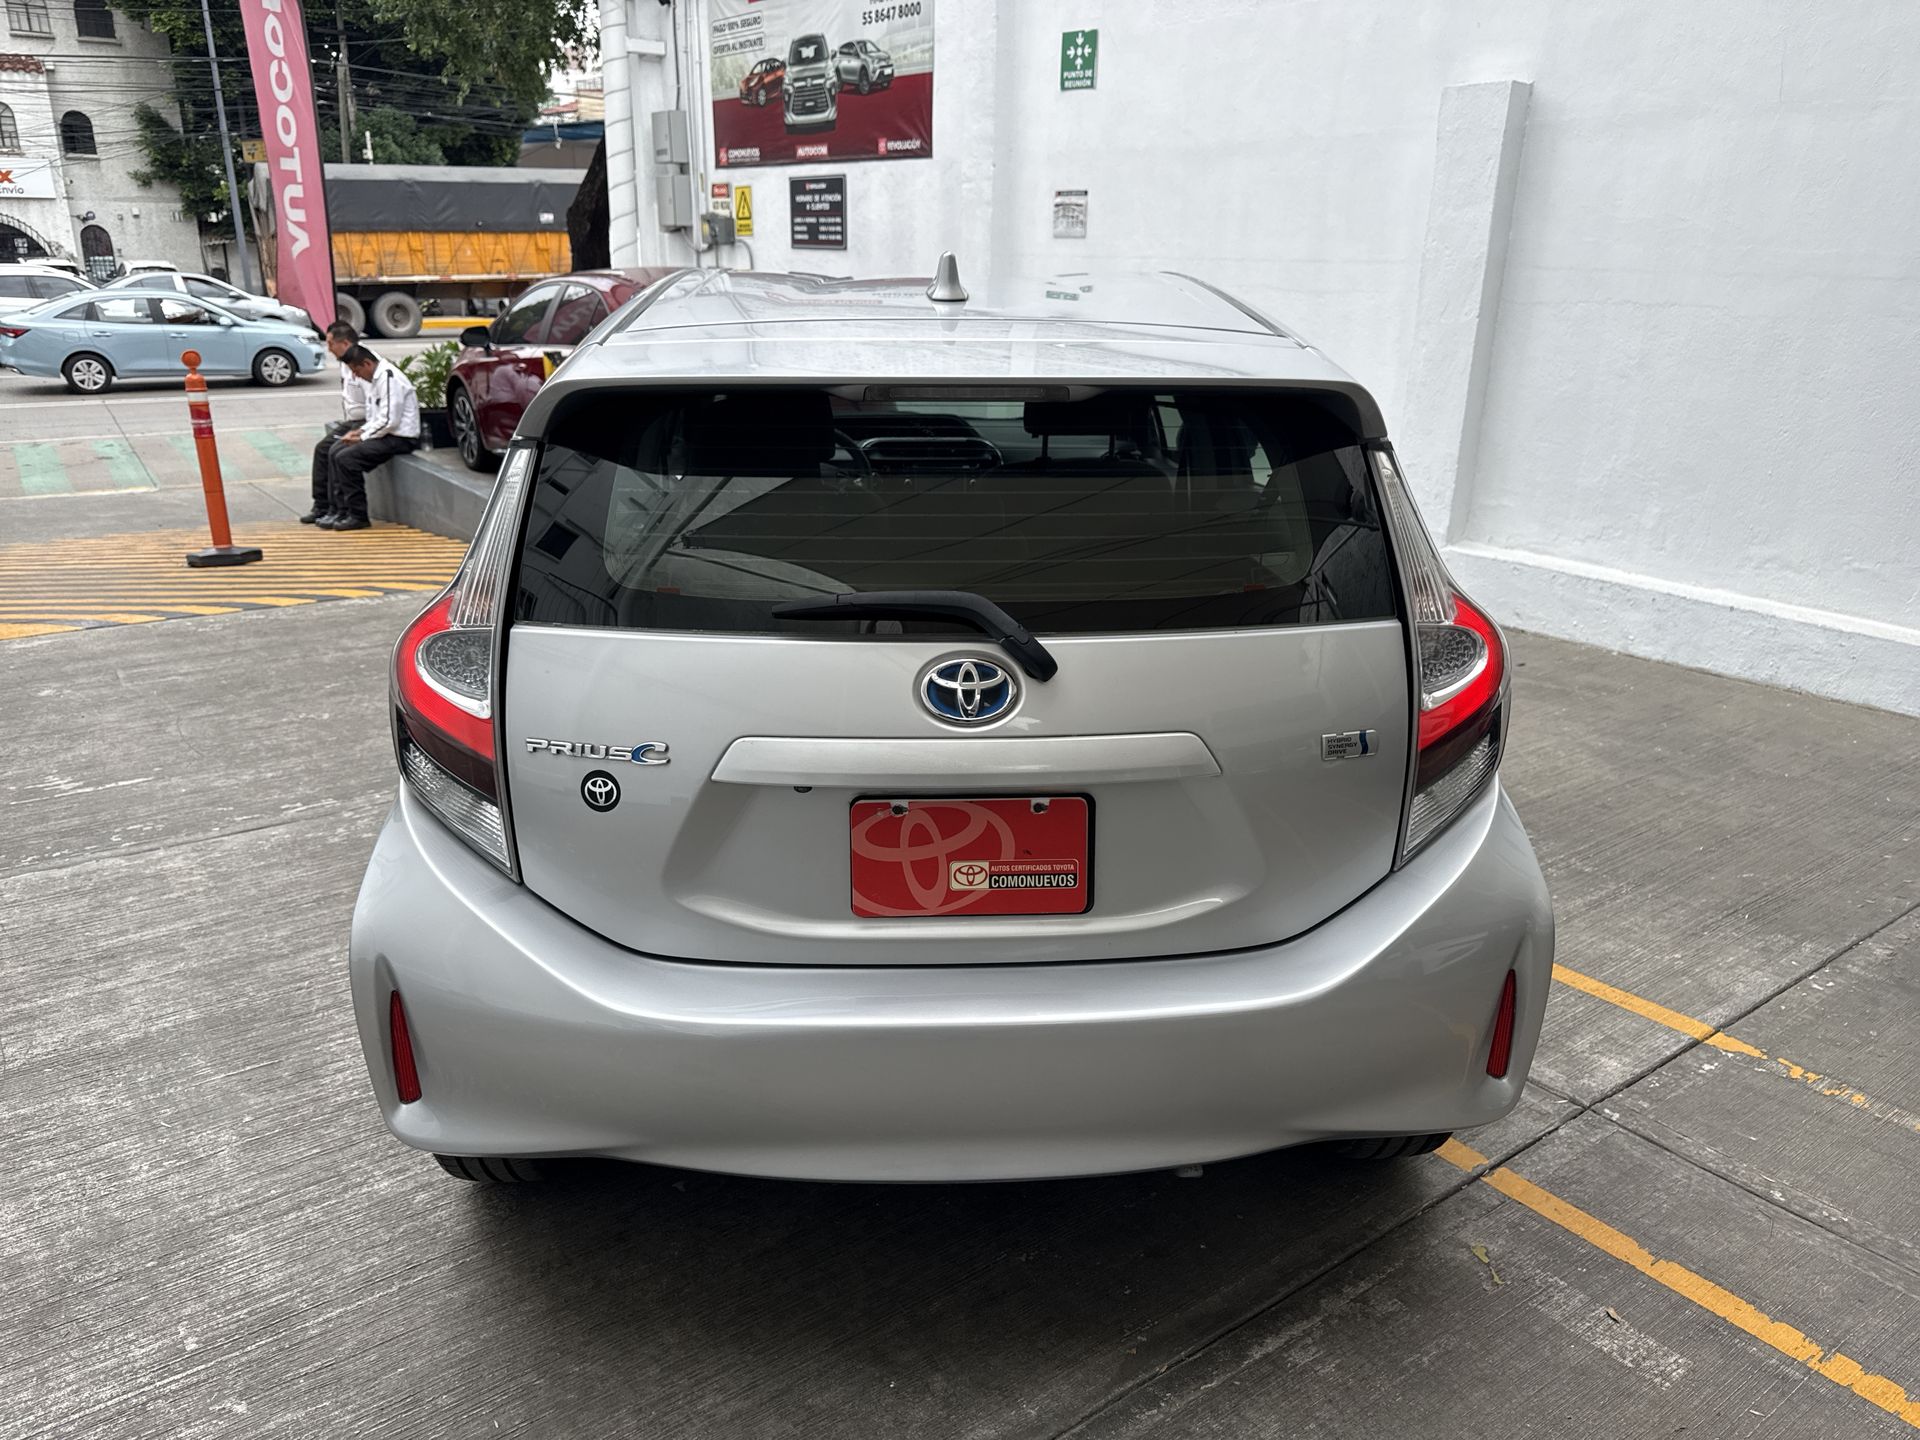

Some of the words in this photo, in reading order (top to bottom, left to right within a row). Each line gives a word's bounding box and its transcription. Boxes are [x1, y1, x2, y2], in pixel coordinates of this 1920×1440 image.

[862, 11, 873, 25] 55
[874, 6, 896, 23] 8647
[898, 1, 921, 18] 8000
[1063, 70, 1084, 79] PUNTO
[1327, 736, 1352, 744] HYBRID
[1327, 742, 1358, 750] SYNERGY
[1327, 748, 1347, 756] DRIVE
[991, 864, 1010, 872] AUTOS
[1011, 864, 1052, 872] CERTIFICADOS
[1053, 863, 1075, 871] TOYOTA
[991, 874, 1075, 888] COMONUEVOS
